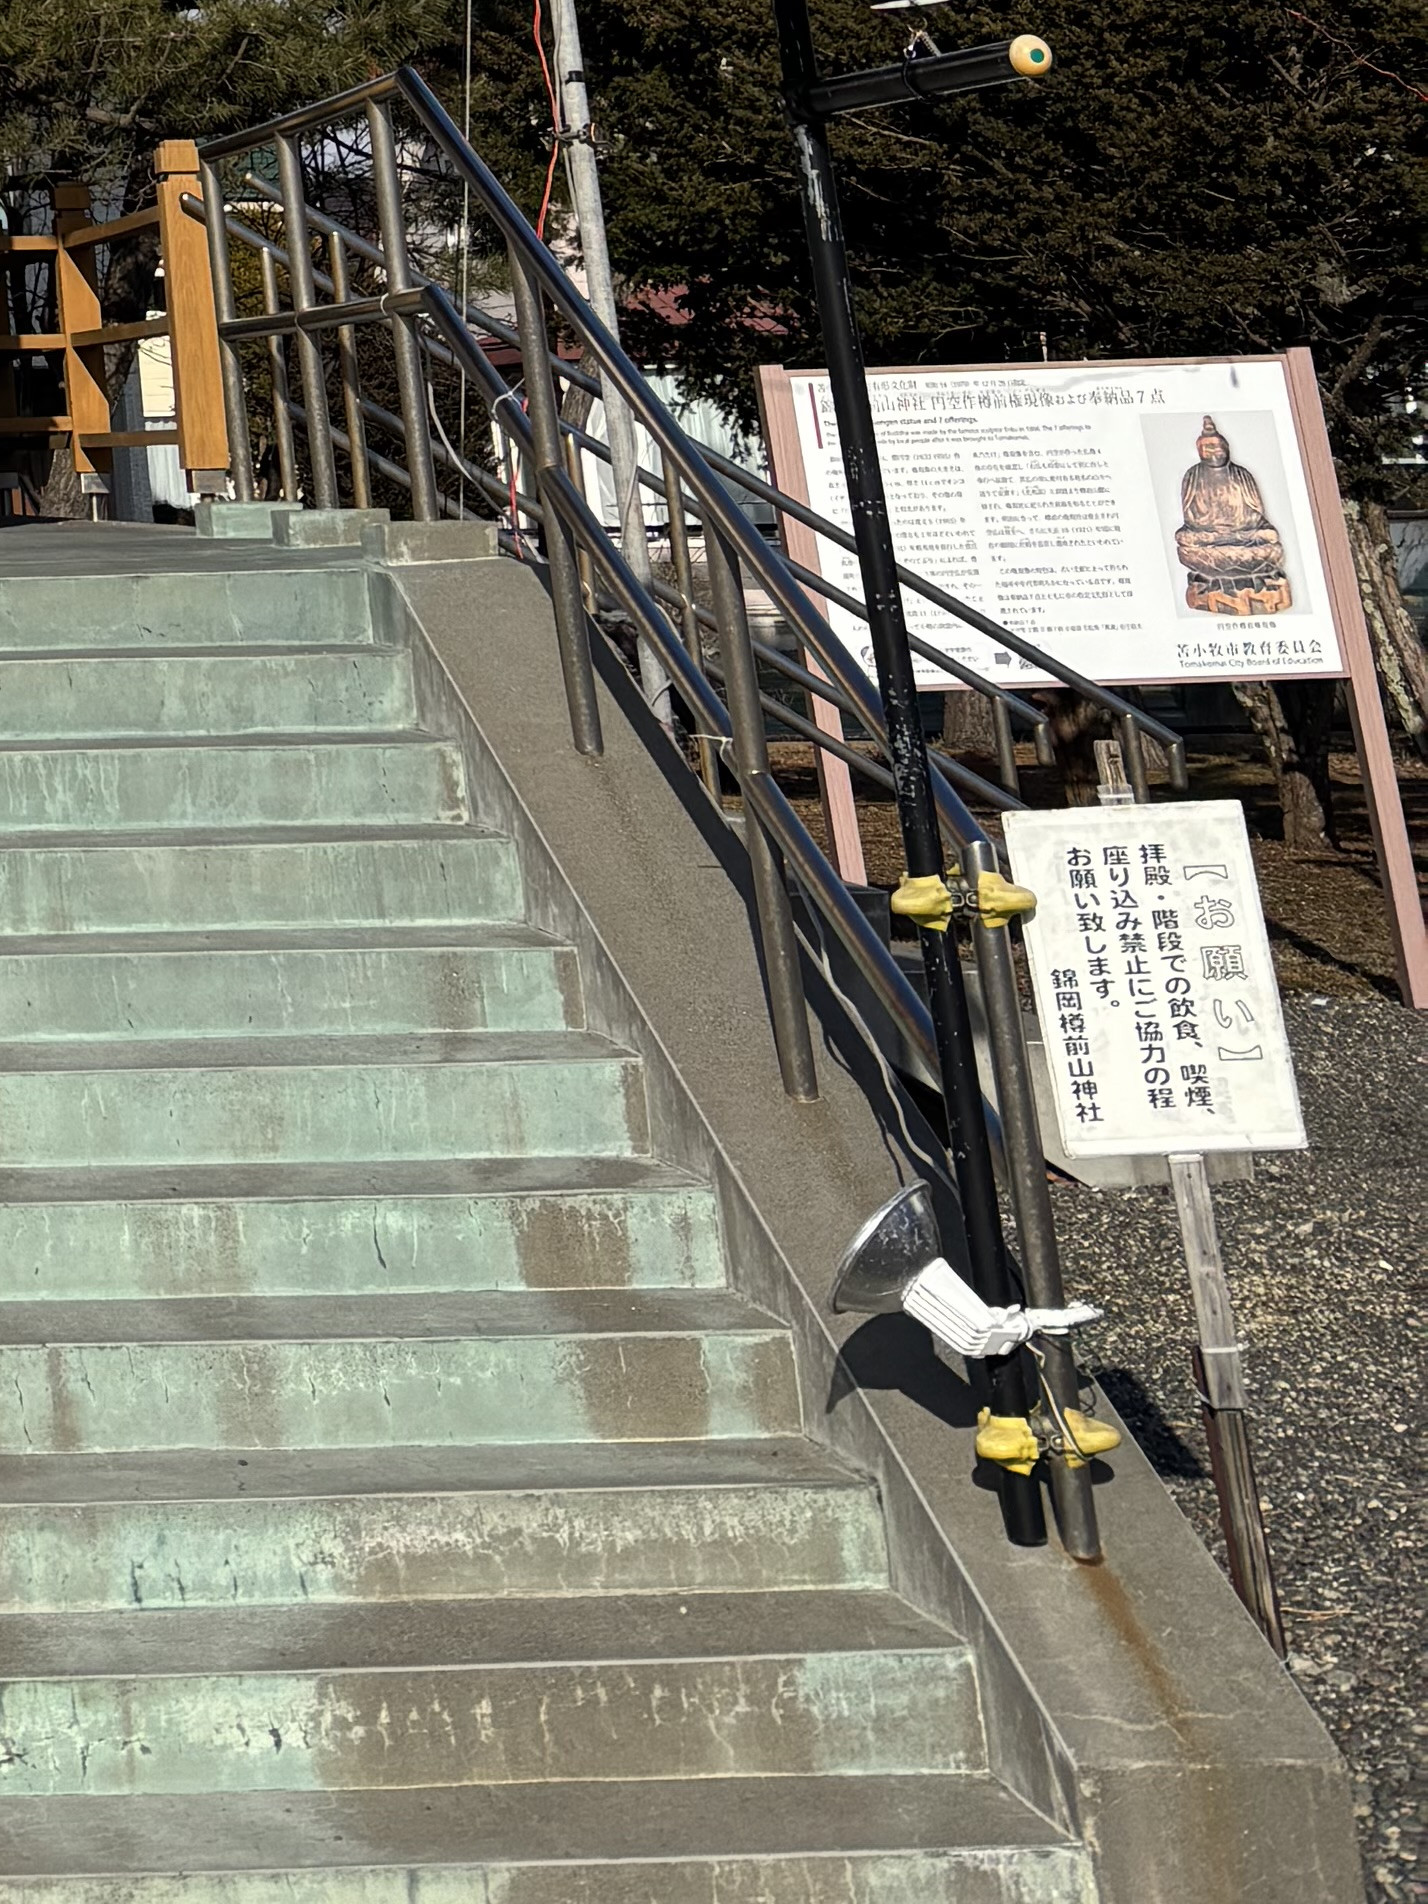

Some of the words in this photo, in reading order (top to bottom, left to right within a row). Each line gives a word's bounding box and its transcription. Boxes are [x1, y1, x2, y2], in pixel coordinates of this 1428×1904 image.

[1177, 639, 1322, 658] 苫小牧市教育委員会
[1228, 658, 1245, 668] City
[1247, 658, 1270, 667] Board
[1066, 846, 1121, 1010] お願い致します。
[1102, 845, 1177, 1110] 座り込み禁止にご協力の程
[1050, 967, 1105, 1124] 錦岡樽前山神社
